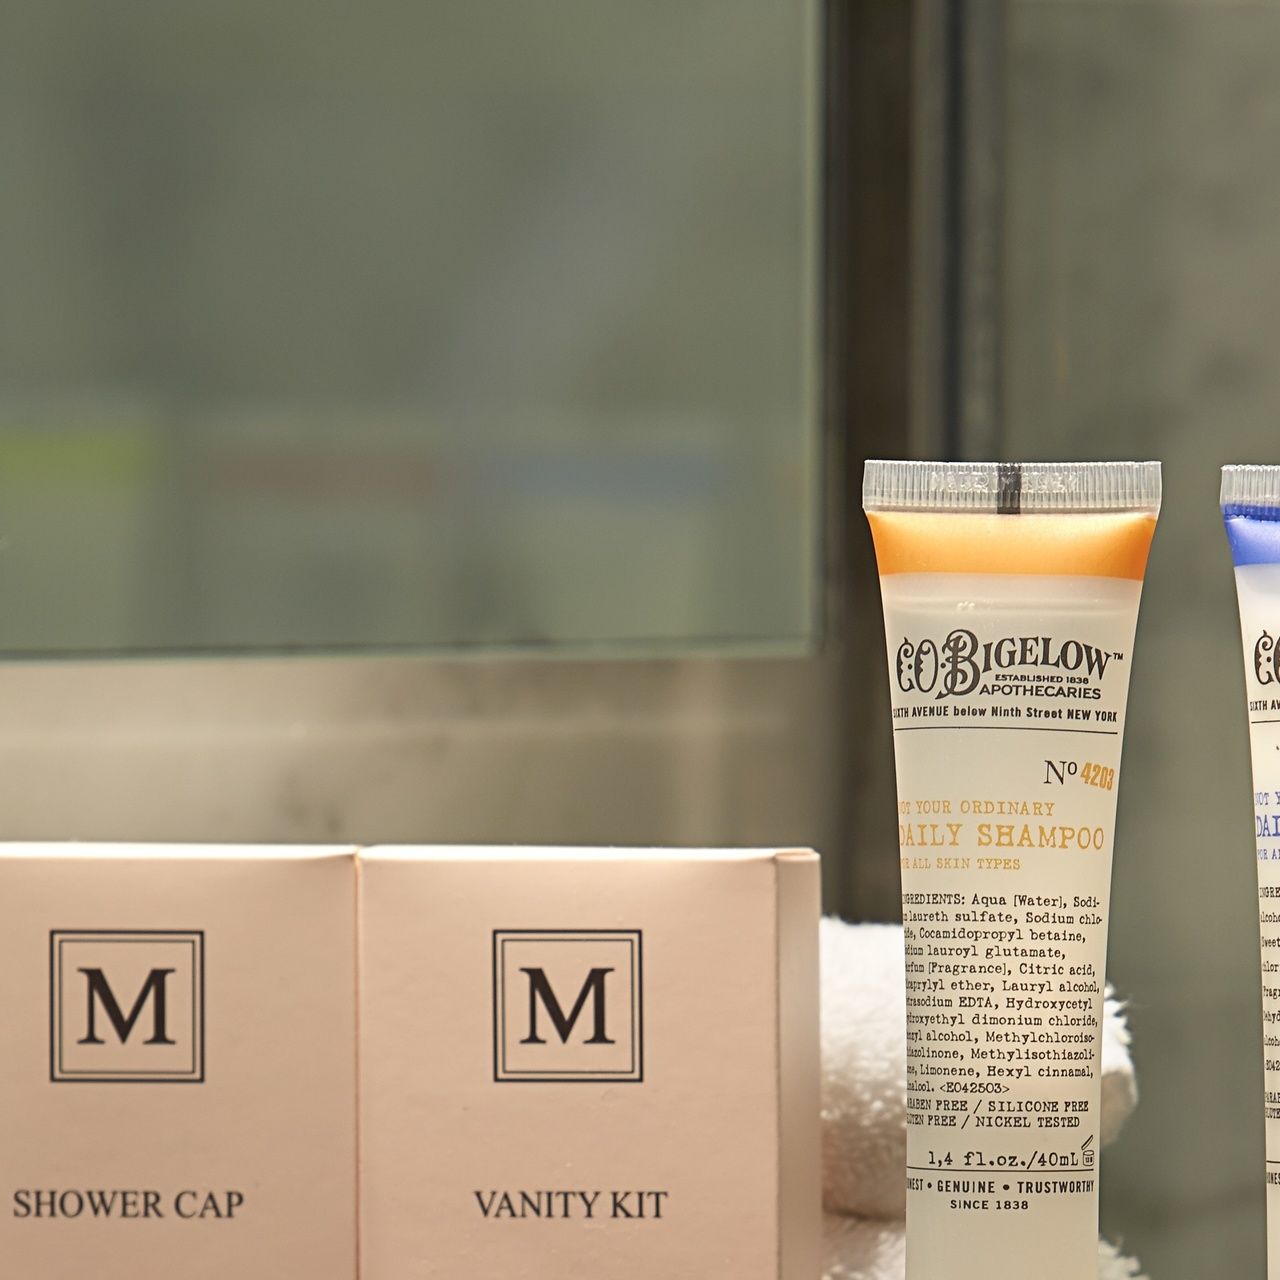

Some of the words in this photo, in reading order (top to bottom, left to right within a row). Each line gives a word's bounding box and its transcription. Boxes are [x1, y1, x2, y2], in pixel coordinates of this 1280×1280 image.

[995, 674, 1063, 683] ESTABLISHED
[979, 685, 1101, 699] APOTHECARIES
[912, 706, 949, 717] AVENUE
[954, 707, 986, 717] below
[992, 707, 1021, 718] Ninth
[1026, 707, 1062, 719] Street
[1067, 709, 1091, 720] NEW
[1095, 711, 1117, 722] YORK
[1081, 762, 1115, 791] 4203
[916, 800, 951, 814] YOUR
[960, 800, 1055, 816] ORDINARY
[977, 824, 1104, 850] SHAMPOO
[913, 859, 931, 869] ALL
[936, 859, 970, 869] SKIN
[977, 859, 1021, 870] TYPES
[972, 894, 1006, 905] Aqua
[955, 911, 1018, 924] sulfate,
[1026, 913, 1074, 924] Sodium
[920, 928, 1023, 940] Cocamidopropyl
[1030, 929, 1086, 942] betaine,
[928, 946, 978, 956] lauroyl
[986, 947, 1066, 959] glutamate,
[1020, 964, 1064, 975] Citric
[1069, 965, 1096, 976] acid,
[951, 980, 995, 992] ether,
[1003, 981, 1053, 992] Lauryl
[1059, 982, 1099, 994] alcohol,
[76, 968, 177, 1046] M
[520, 966, 616, 1046] M
[959, 998, 999, 1010] EDTA,
[1006, 998, 1092, 1010] Hydroxycetyl
[972, 1015, 1042, 1026] dimonium
[1049, 1016, 1098, 1027] chloride,
[926, 1031, 978, 1043] alcohol,
[920, 1065, 980, 1076] Limonene,
[987, 1066, 1031, 1077] Hexyl
[1038, 1066, 1094, 1079] cinnamal,
[936, 1100, 968, 1111] FREE
[989, 1101, 1059, 1112] SILICONE
[1065, 1101, 1088, 1112] FREE
[928, 1116, 956, 1126] FREE
[976, 1117, 1031, 1128] NICKEL
[1038, 1117, 1080, 1128] TESTED
[929, 1151, 953, 1167] 1,4
[938, 1181, 995, 1193] GENUINE
[1017, 1181, 1094, 1193] TRUSTWORTHY
[12, 1190, 165, 1220] SHOWER
[174, 1190, 244, 1220] CAP
[474, 1190, 600, 1220] VANITY
[610, 1190, 669, 1220] KIT
[950, 1200, 989, 1210] SINCE
[996, 1201, 1029, 1210] 1838
